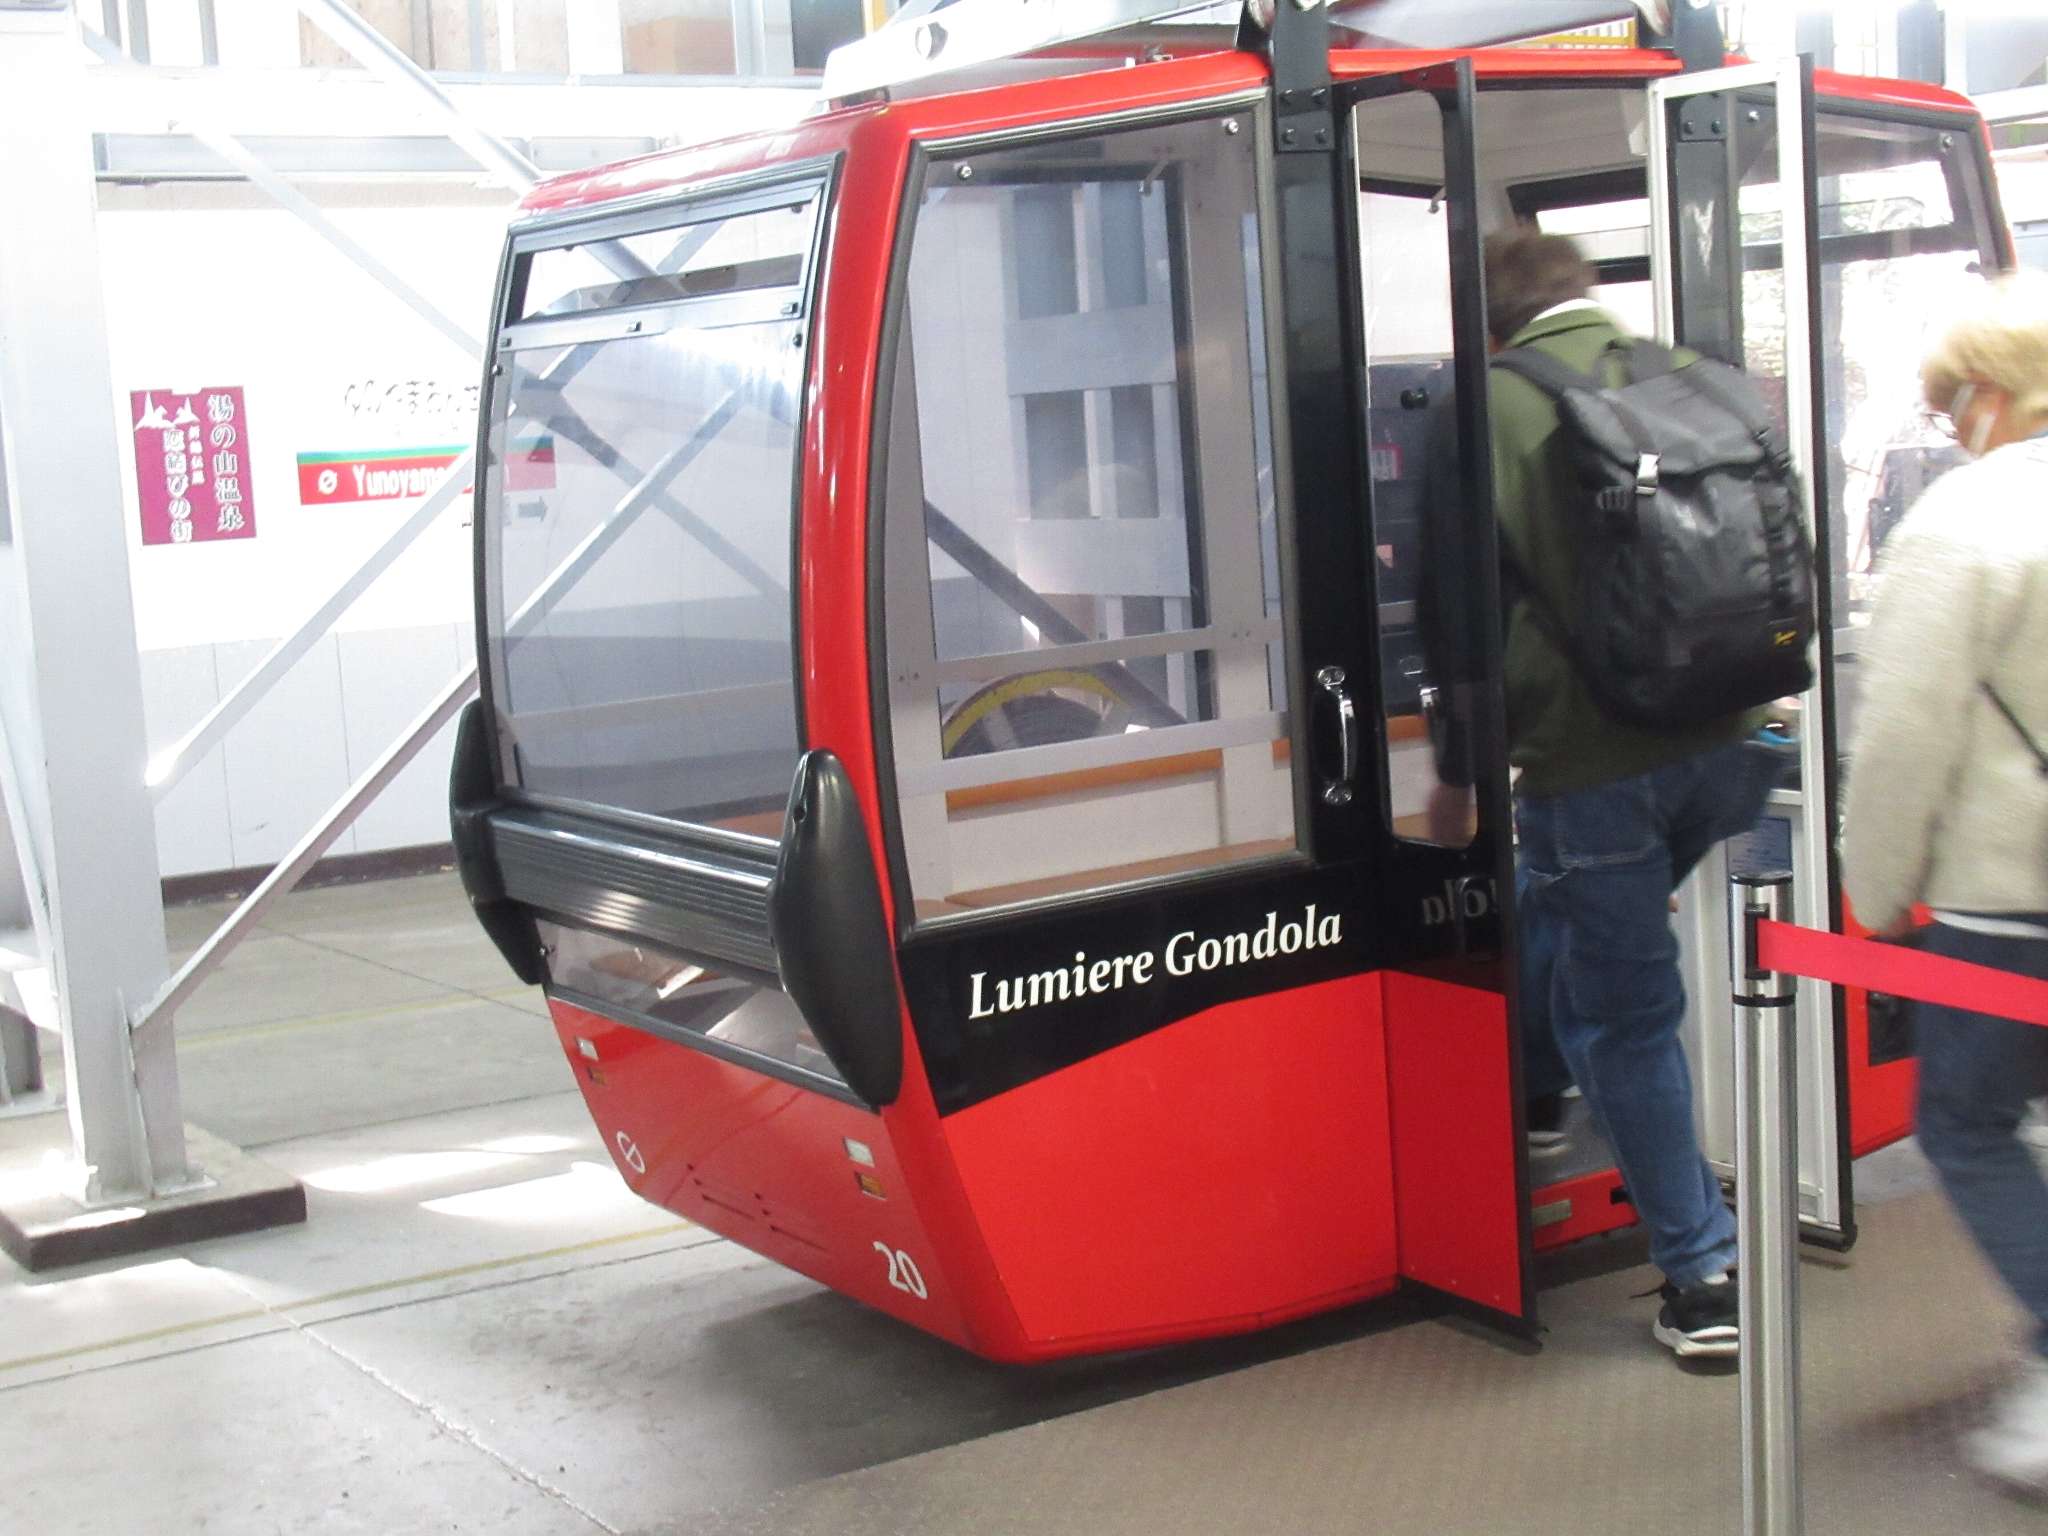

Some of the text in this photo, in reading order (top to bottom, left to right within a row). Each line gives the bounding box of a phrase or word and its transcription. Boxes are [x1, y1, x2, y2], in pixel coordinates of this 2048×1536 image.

[207, 393, 246, 532] 湯の山温泉
[968, 904, 1343, 1020] Lumiere Gondola
[872, 1240, 928, 1300] 20
